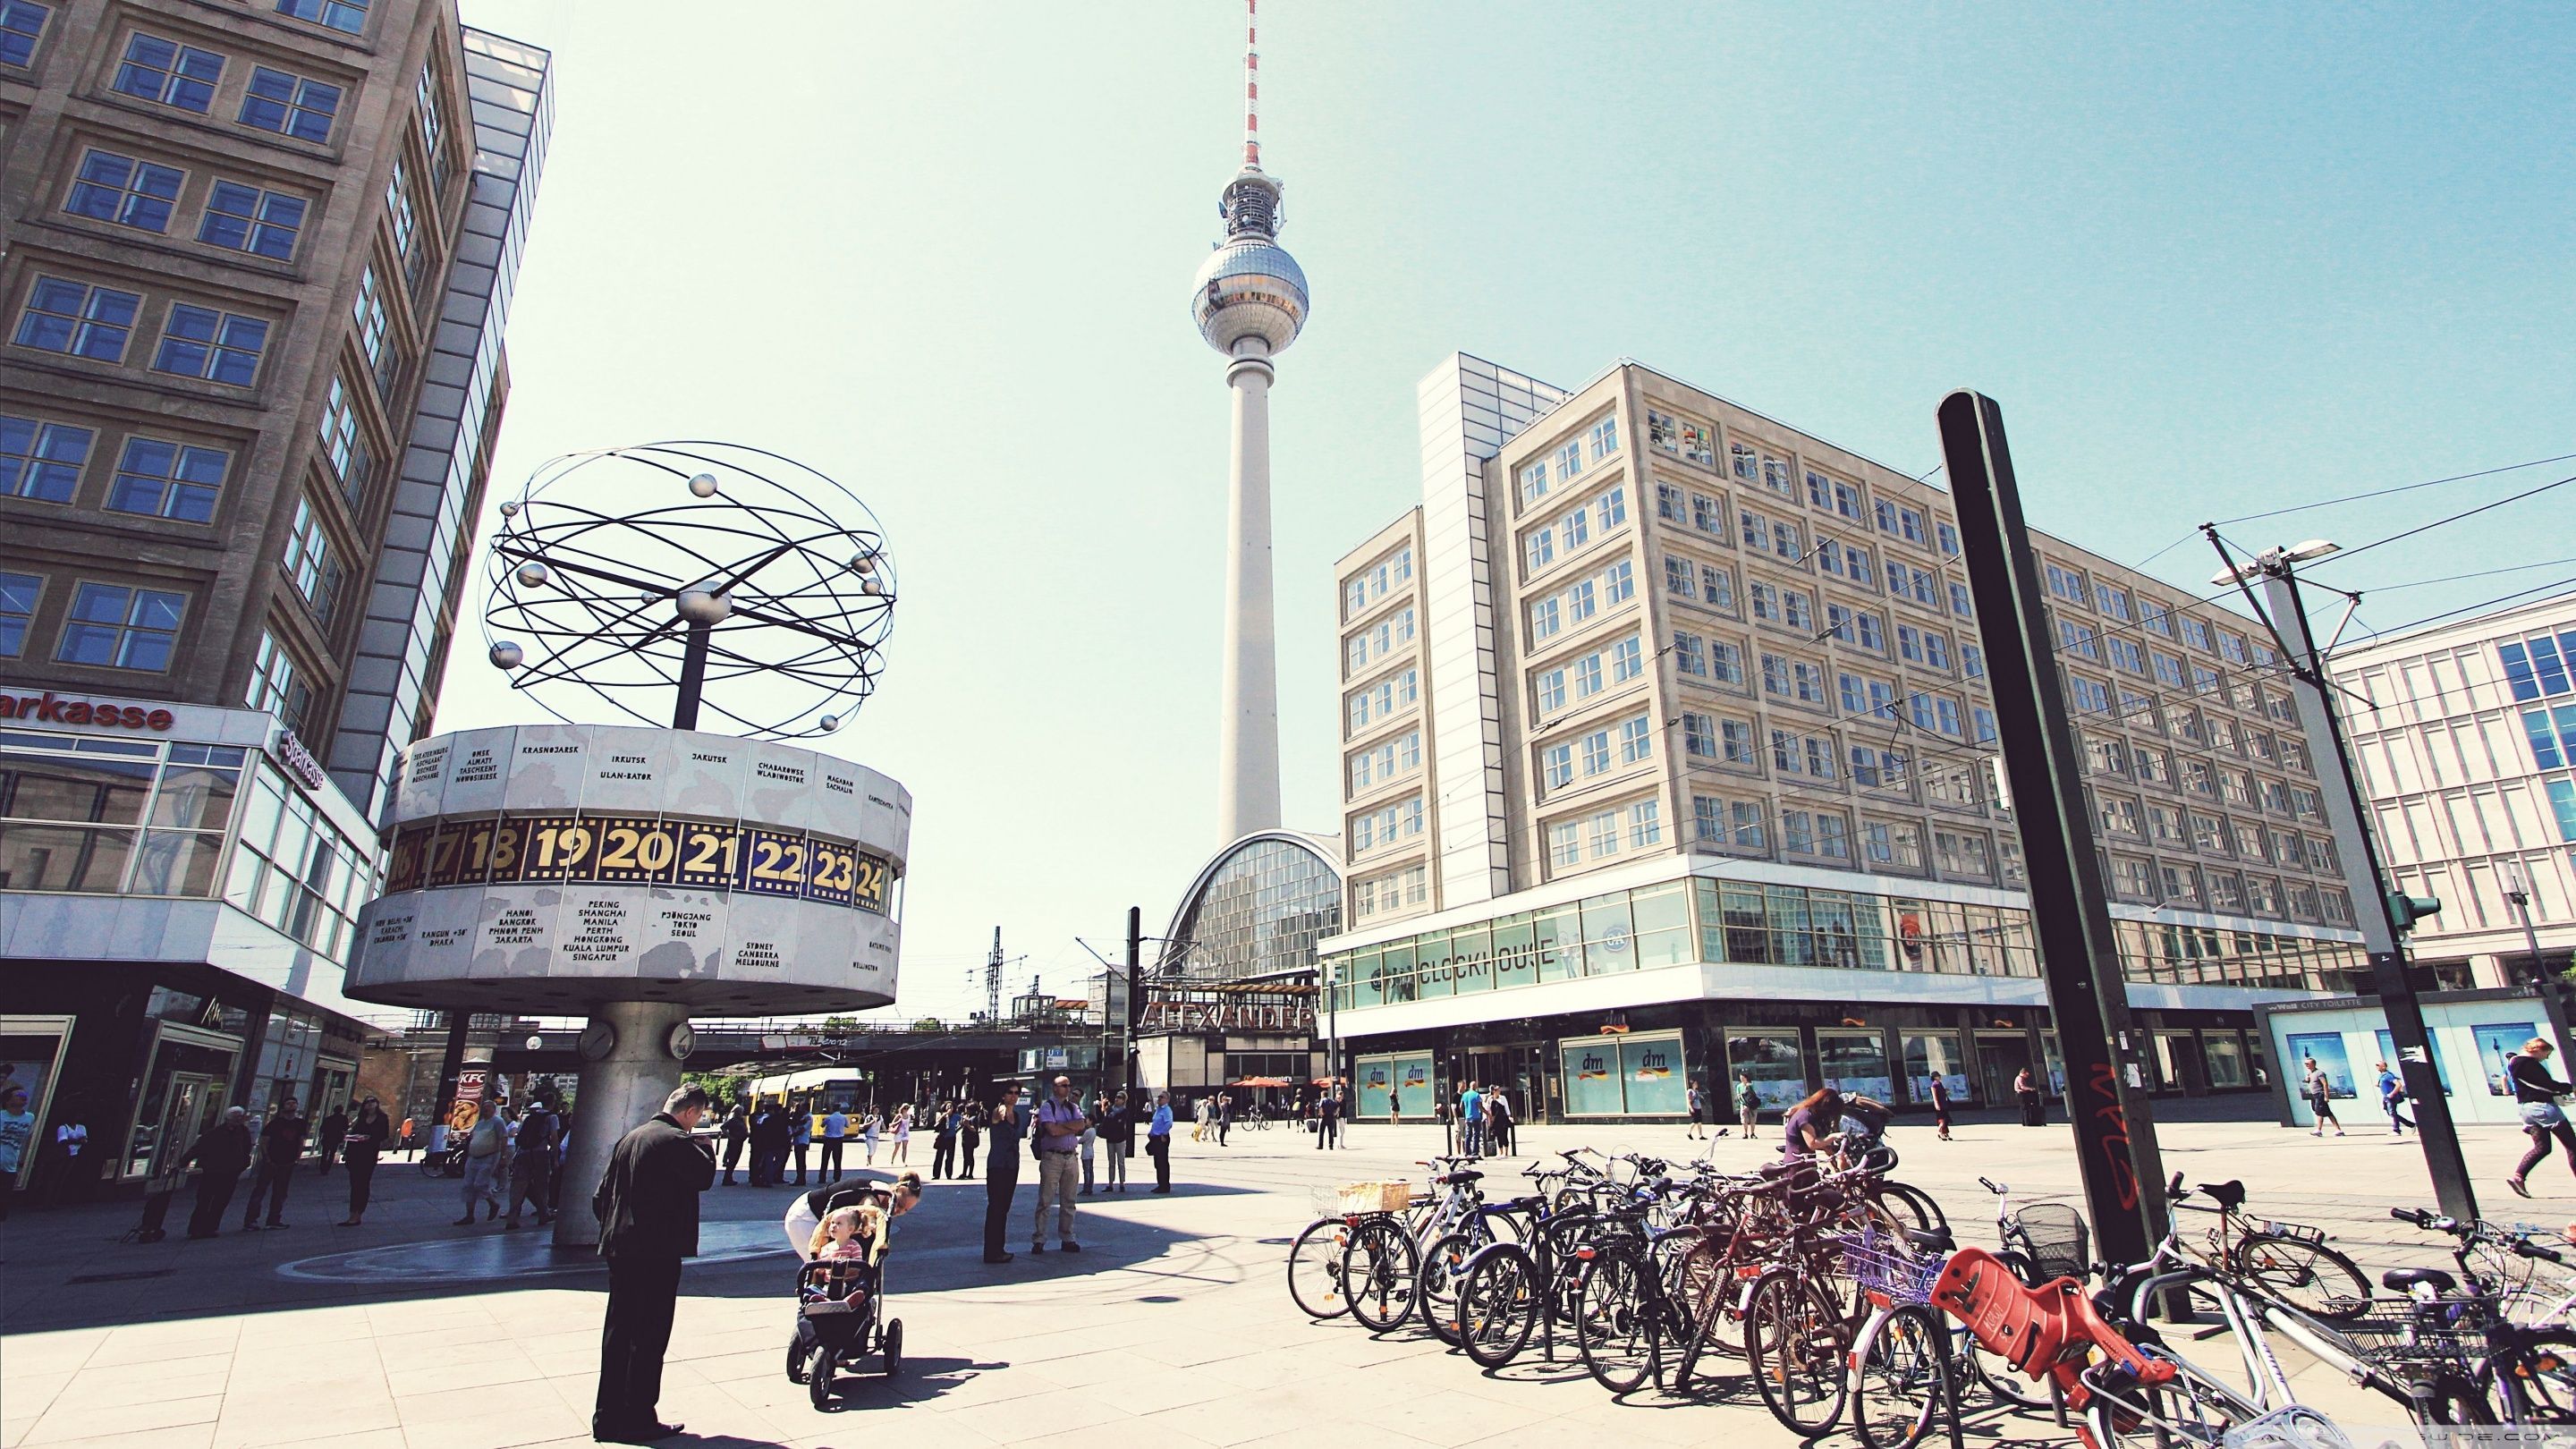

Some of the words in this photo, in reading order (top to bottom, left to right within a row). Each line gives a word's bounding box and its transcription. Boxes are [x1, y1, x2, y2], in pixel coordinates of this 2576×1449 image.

[471, 750, 491, 758] OMSK
[521, 746, 579, 754] KRASNOJARSK
[279, 730, 324, 792] Sparkasse
[466, 757, 493, 767] ALMATY
[611, 756, 647, 764] IRKUTSK
[691, 753, 727, 764] JAKUTSK
[459, 765, 497, 775] TASCHKENT
[758, 762, 805, 776] CHABAROWSK
[455, 772, 497, 784] NOWOSIBIRSK
[600, 771, 652, 781] ULAN-BATOR
[757, 770, 805, 784] WLADIWOSTOK
[826, 775, 854, 787] MAGADAN
[826, 783, 853, 794] SACHALIN
[421, 833, 461, 874] 17
[470, 828, 518, 870] 18
[537, 828, 592, 867] 19
[600, 828, 674, 870] 20
[683, 833, 740, 874] 21
[752, 841, 809, 883] 22
[812, 851, 854, 892] 23
[856, 860, 882, 902] 24
[588, 901, 620, 909] PEKING
[578, 909, 627, 918] SHANGHAI
[583, 918, 618, 926] MANILA
[673, 920, 698, 928] TOKYO
[421, 929, 450, 938] RANGUN
[521, 927, 544, 935] PENH
[671, 929, 697, 937] SEOUL
[429, 938, 454, 946] DHAKA
[495, 936, 533, 944] JAKARTA
[573, 936, 623, 944] HONGKONG
[596, 945, 630, 953] LUMPUR
[746, 942, 774, 951] SYDNEY
[572, 953, 617, 962] SINGAPUR
[738, 950, 779, 960] CANBERRA
[735, 958, 780, 968] MELBOURNE
[852, 962, 878, 971] WELLINGTON
[2301, 1001, 2319, 1009] CITY
[2323, 998, 2362, 1008] TOILETTE
[1140, 1004, 1314, 1030] ALEXANDER
[1582, 1053, 1603, 1071] dm
[1642, 1048, 1665, 1067] dm
[1370, 1067, 1385, 1081] dm
[1408, 1064, 1423, 1080] dm
[460, 1073, 486, 1083] KFC
